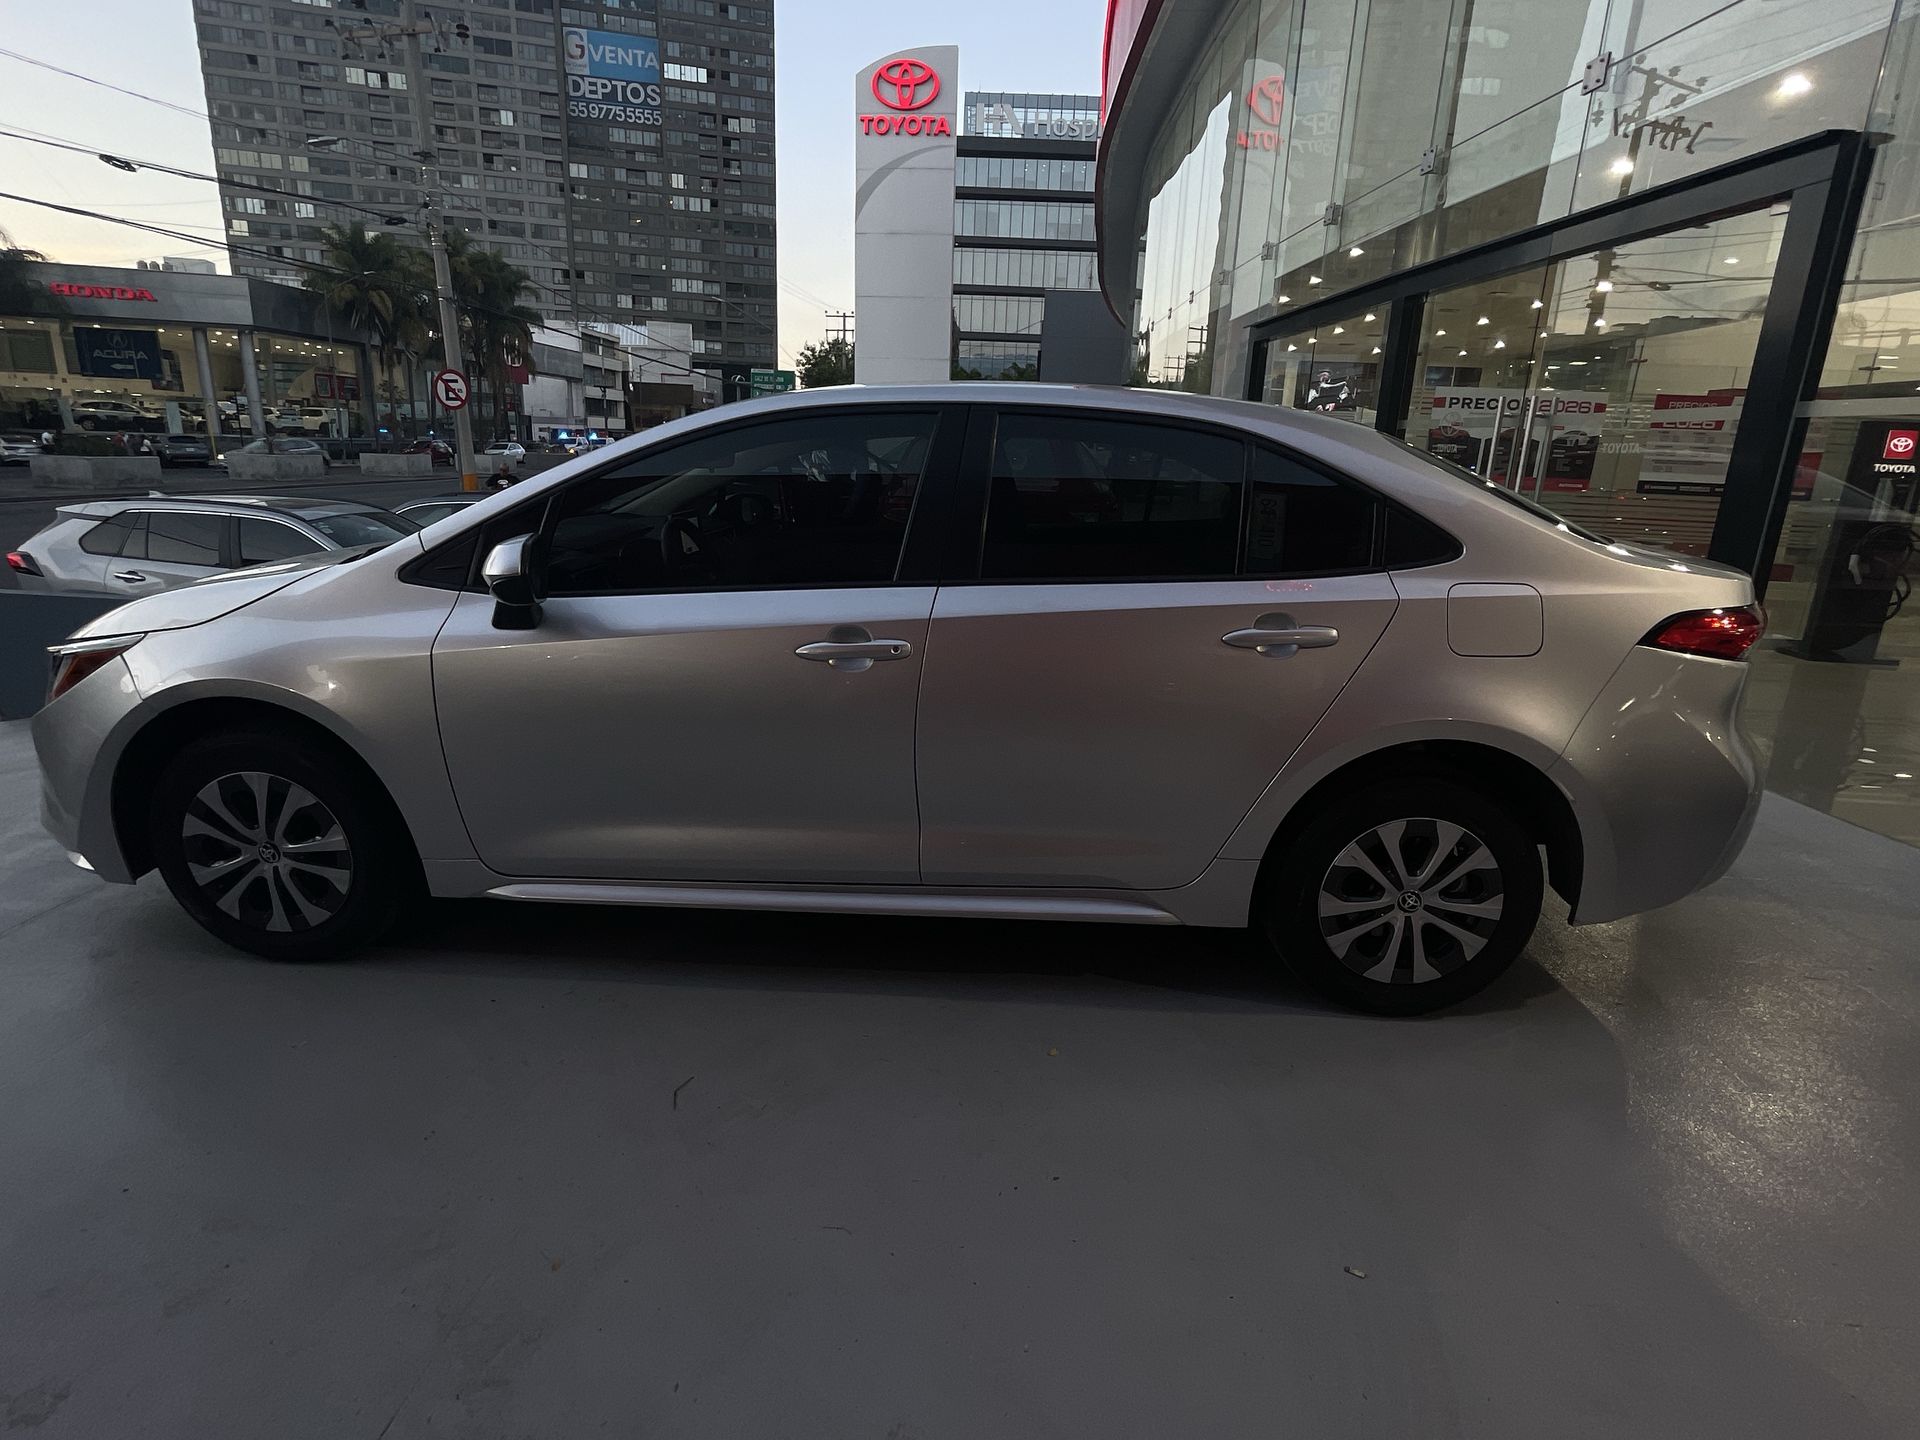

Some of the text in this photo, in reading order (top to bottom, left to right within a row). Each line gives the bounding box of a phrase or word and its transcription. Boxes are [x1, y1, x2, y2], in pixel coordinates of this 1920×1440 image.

[589, 44, 659, 70] VENTA
[568, 76, 660, 105] DEPTOS
[569, 101, 662, 125] 5597755555
[860, 115, 950, 136] TOYOTA
[1034, 111, 1101, 141] Hosp
[49, 281, 158, 302] HONDA
[93, 349, 148, 360] ACURA
[442, 379, 460, 401] E
[1602, 443, 1640, 454] TOYOTA
[1874, 464, 1916, 473] TOYOTA
